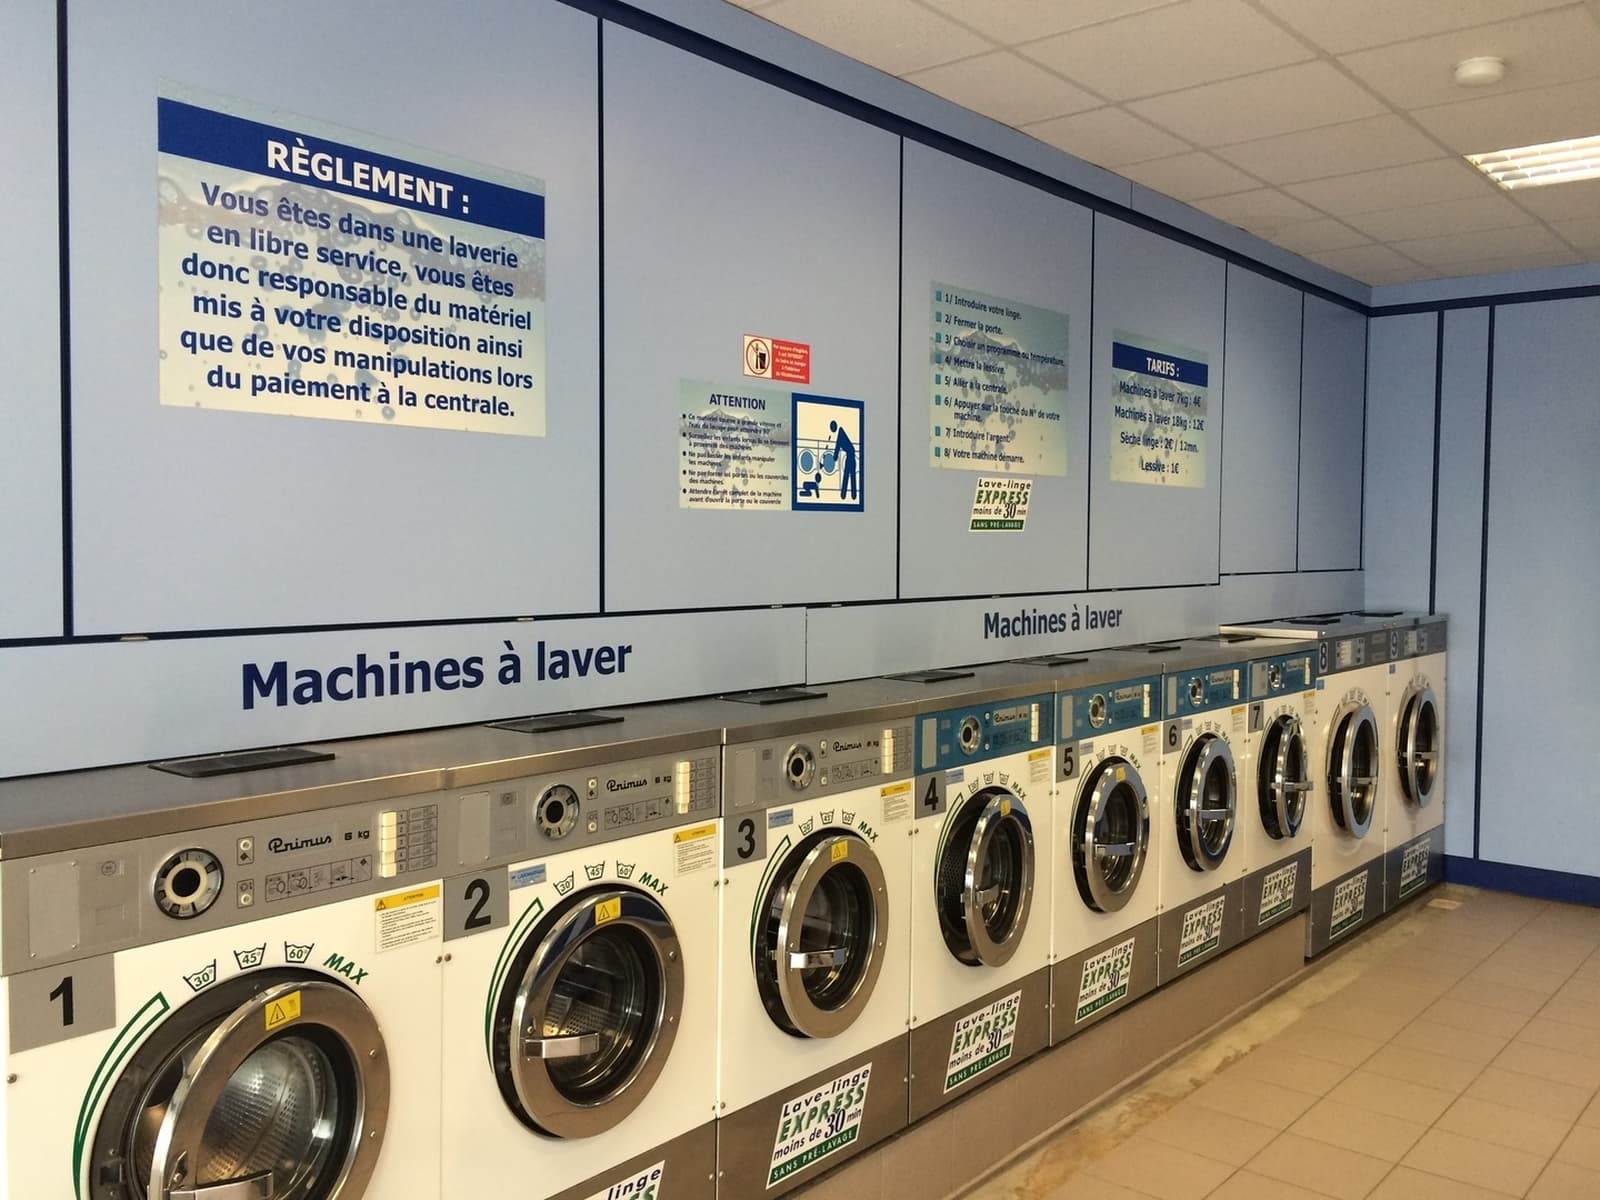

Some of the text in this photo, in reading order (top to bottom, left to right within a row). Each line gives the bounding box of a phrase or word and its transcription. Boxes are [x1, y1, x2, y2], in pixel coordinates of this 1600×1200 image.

[266, 138, 453, 208] RÈGLEMENT
[201, 183, 518, 268] Vous êtes dans une laverie
[207, 225, 514, 297] en libre service, vous êtes
[182, 254, 531, 330] donc responsable du matériel
[955, 296, 987, 312] Introduire
[989, 306, 1004, 316] votre
[1006, 308, 1022, 320] linge.
[193, 294, 523, 358] mis à votre disposition ainsi
[954, 316, 976, 329] Fermer
[978, 321, 983, 330] la
[985, 324, 1003, 334] porte.
[180, 329, 532, 389] que de vos manipulations lors
[954, 336, 975, 348] Choisir
[986, 345, 1020, 358] programme
[954, 356, 975, 369] Mettre
[976, 361, 982, 370] la
[1146, 357, 1175, 376] TARIFS
[207, 366, 515, 417] du paiement à la centrale.
[954, 378, 968, 389] Aller
[975, 381, 980, 390] la
[982, 382, 1008, 394] centrale.
[1120, 381, 1151, 399] Machines
[1153, 386, 1157, 399] à
[1159, 389, 1175, 402] laver
[710, 394, 765, 410] ATTENTION
[954, 398, 980, 412] Appuyer
[981, 403, 991, 411] sur
[993, 404, 998, 412] la
[1000, 404, 1019, 415] touche
[1021, 407, 1028, 416] du
[1038, 410, 1044, 419] de
[1046, 412, 1060, 420] votre
[1115, 406, 1146, 422] Machines
[1149, 410, 1152, 423] à
[1154, 412, 1170, 426] laver
[953, 428, 985, 440] Introduire
[1143, 433, 1159, 450] linge
[953, 449, 970, 459] Votre
[972, 450, 997, 461] machine
[999, 452, 1024, 463] démarre.
[1141, 458, 1165, 473] Lessive
[979, 479, 1031, 491] Lave-linge
[976, 490, 1028, 505] EXPRESS
[973, 506, 991, 515] moins
[994, 506, 1002, 515] de
[1003, 503, 1016, 519] 30
[984, 604, 1122, 639] Machines à laver
[1320, 642, 1327, 670] 8
[1392, 632, 1398, 656] 9
[242, 641, 632, 709] Machines à laver
[1253, 705, 1260, 728] 7
[1169, 725, 1177, 746] 6
[1063, 747, 1073, 776] 5
[606, 777, 648, 792] Primus
[924, 777, 938, 811] 4
[268, 830, 370, 853] Primus kg
[737, 818, 755, 859] 3
[858, 821, 879, 843] MAX
[639, 872, 668, 896] MAX
[464, 878, 491, 930] 2
[1184, 908, 1222, 939] EXPRESS
[323, 952, 368, 985] MAX
[1085, 942, 1133, 971] Lave-linge
[1082, 952, 1131, 990] EXPRESS
[49, 976, 74, 1026] 1
[956, 996, 1020, 1033] Lave-linge
[952, 1007, 1017, 1055] EXPRESS
[949, 1050, 972, 1069] moins
[975, 1043, 984, 1056] de
[986, 1029, 1002, 1053] 30
[950, 1071, 967, 1085] SANS
[783, 1069, 870, 1118] Lave-linge
[779, 1082, 865, 1144] EXPRESS
[774, 1109, 861, 1160] moins de 30 min
[774, 1160, 797, 1179] SANS
